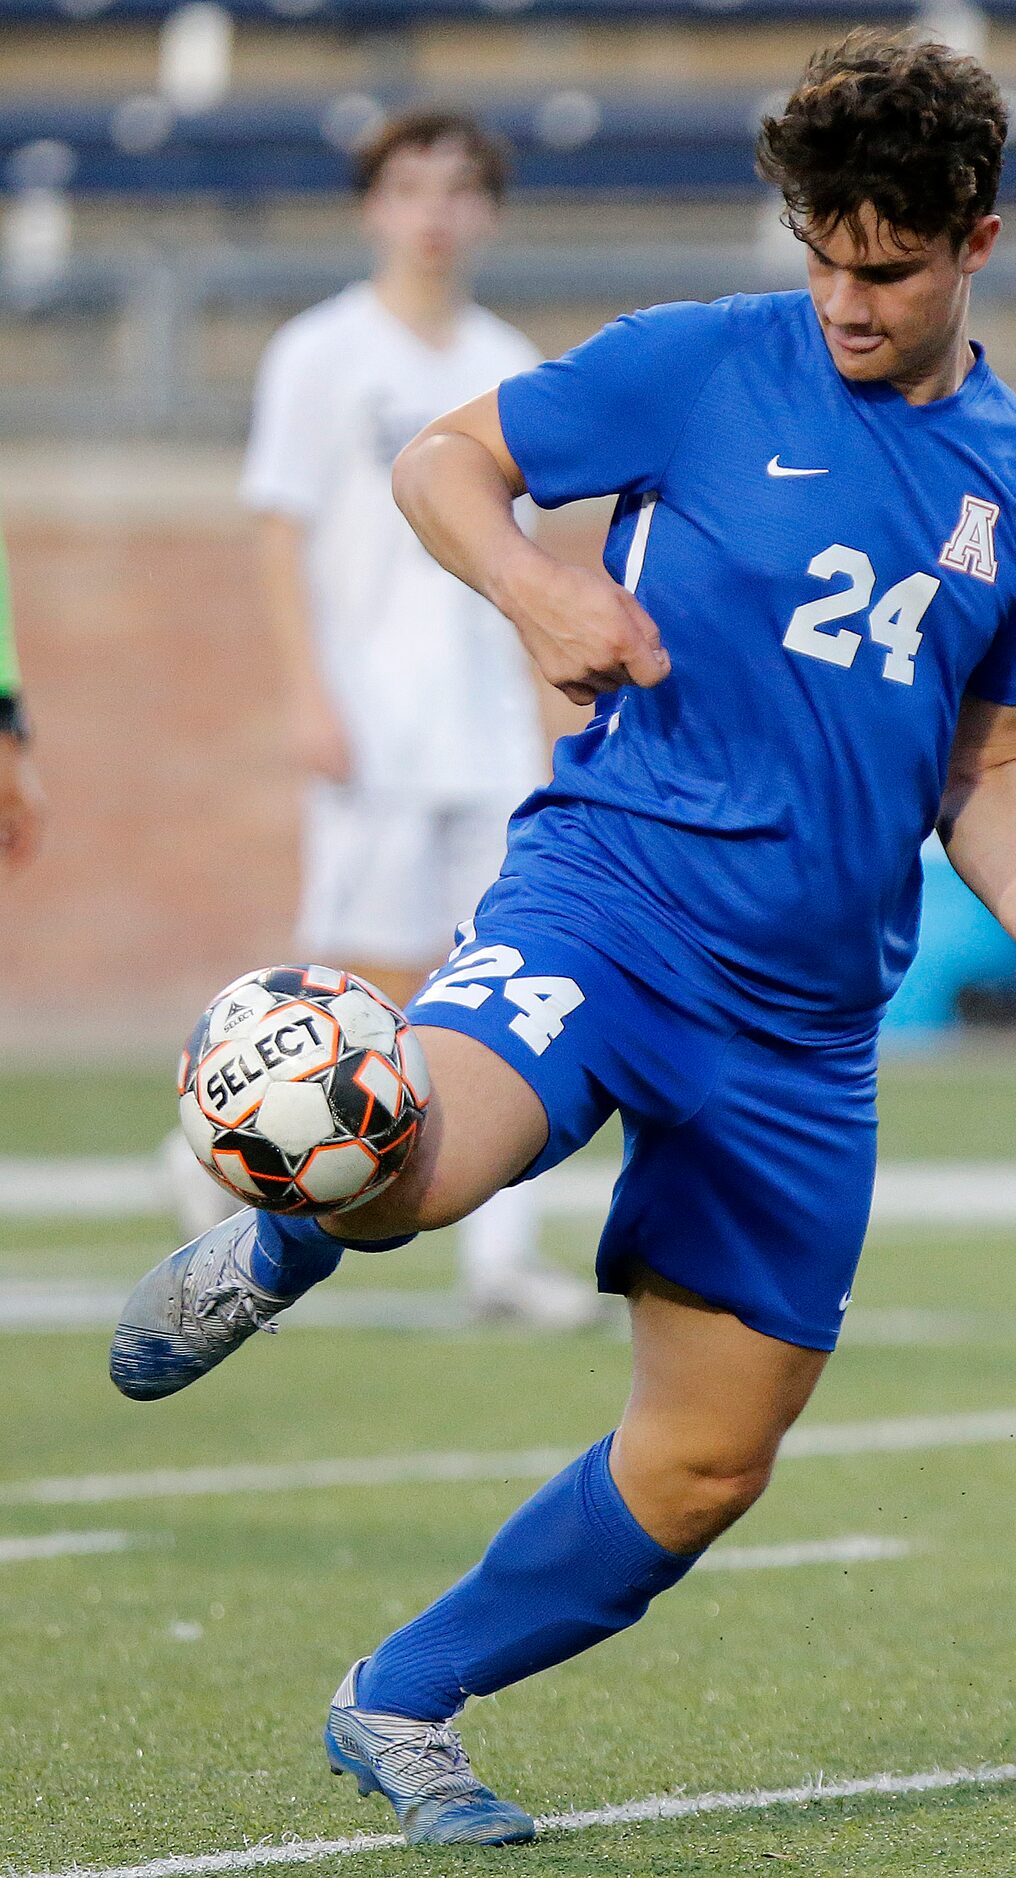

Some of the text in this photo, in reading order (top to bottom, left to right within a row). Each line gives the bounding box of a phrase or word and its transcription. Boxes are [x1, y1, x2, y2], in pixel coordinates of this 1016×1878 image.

[939, 494, 1000, 584] A
[783, 543, 942, 687] 24
[224, 1009, 255, 1033] SELECT
[415, 944, 587, 1057] 24
[207, 1016, 322, 1111] SELECT
